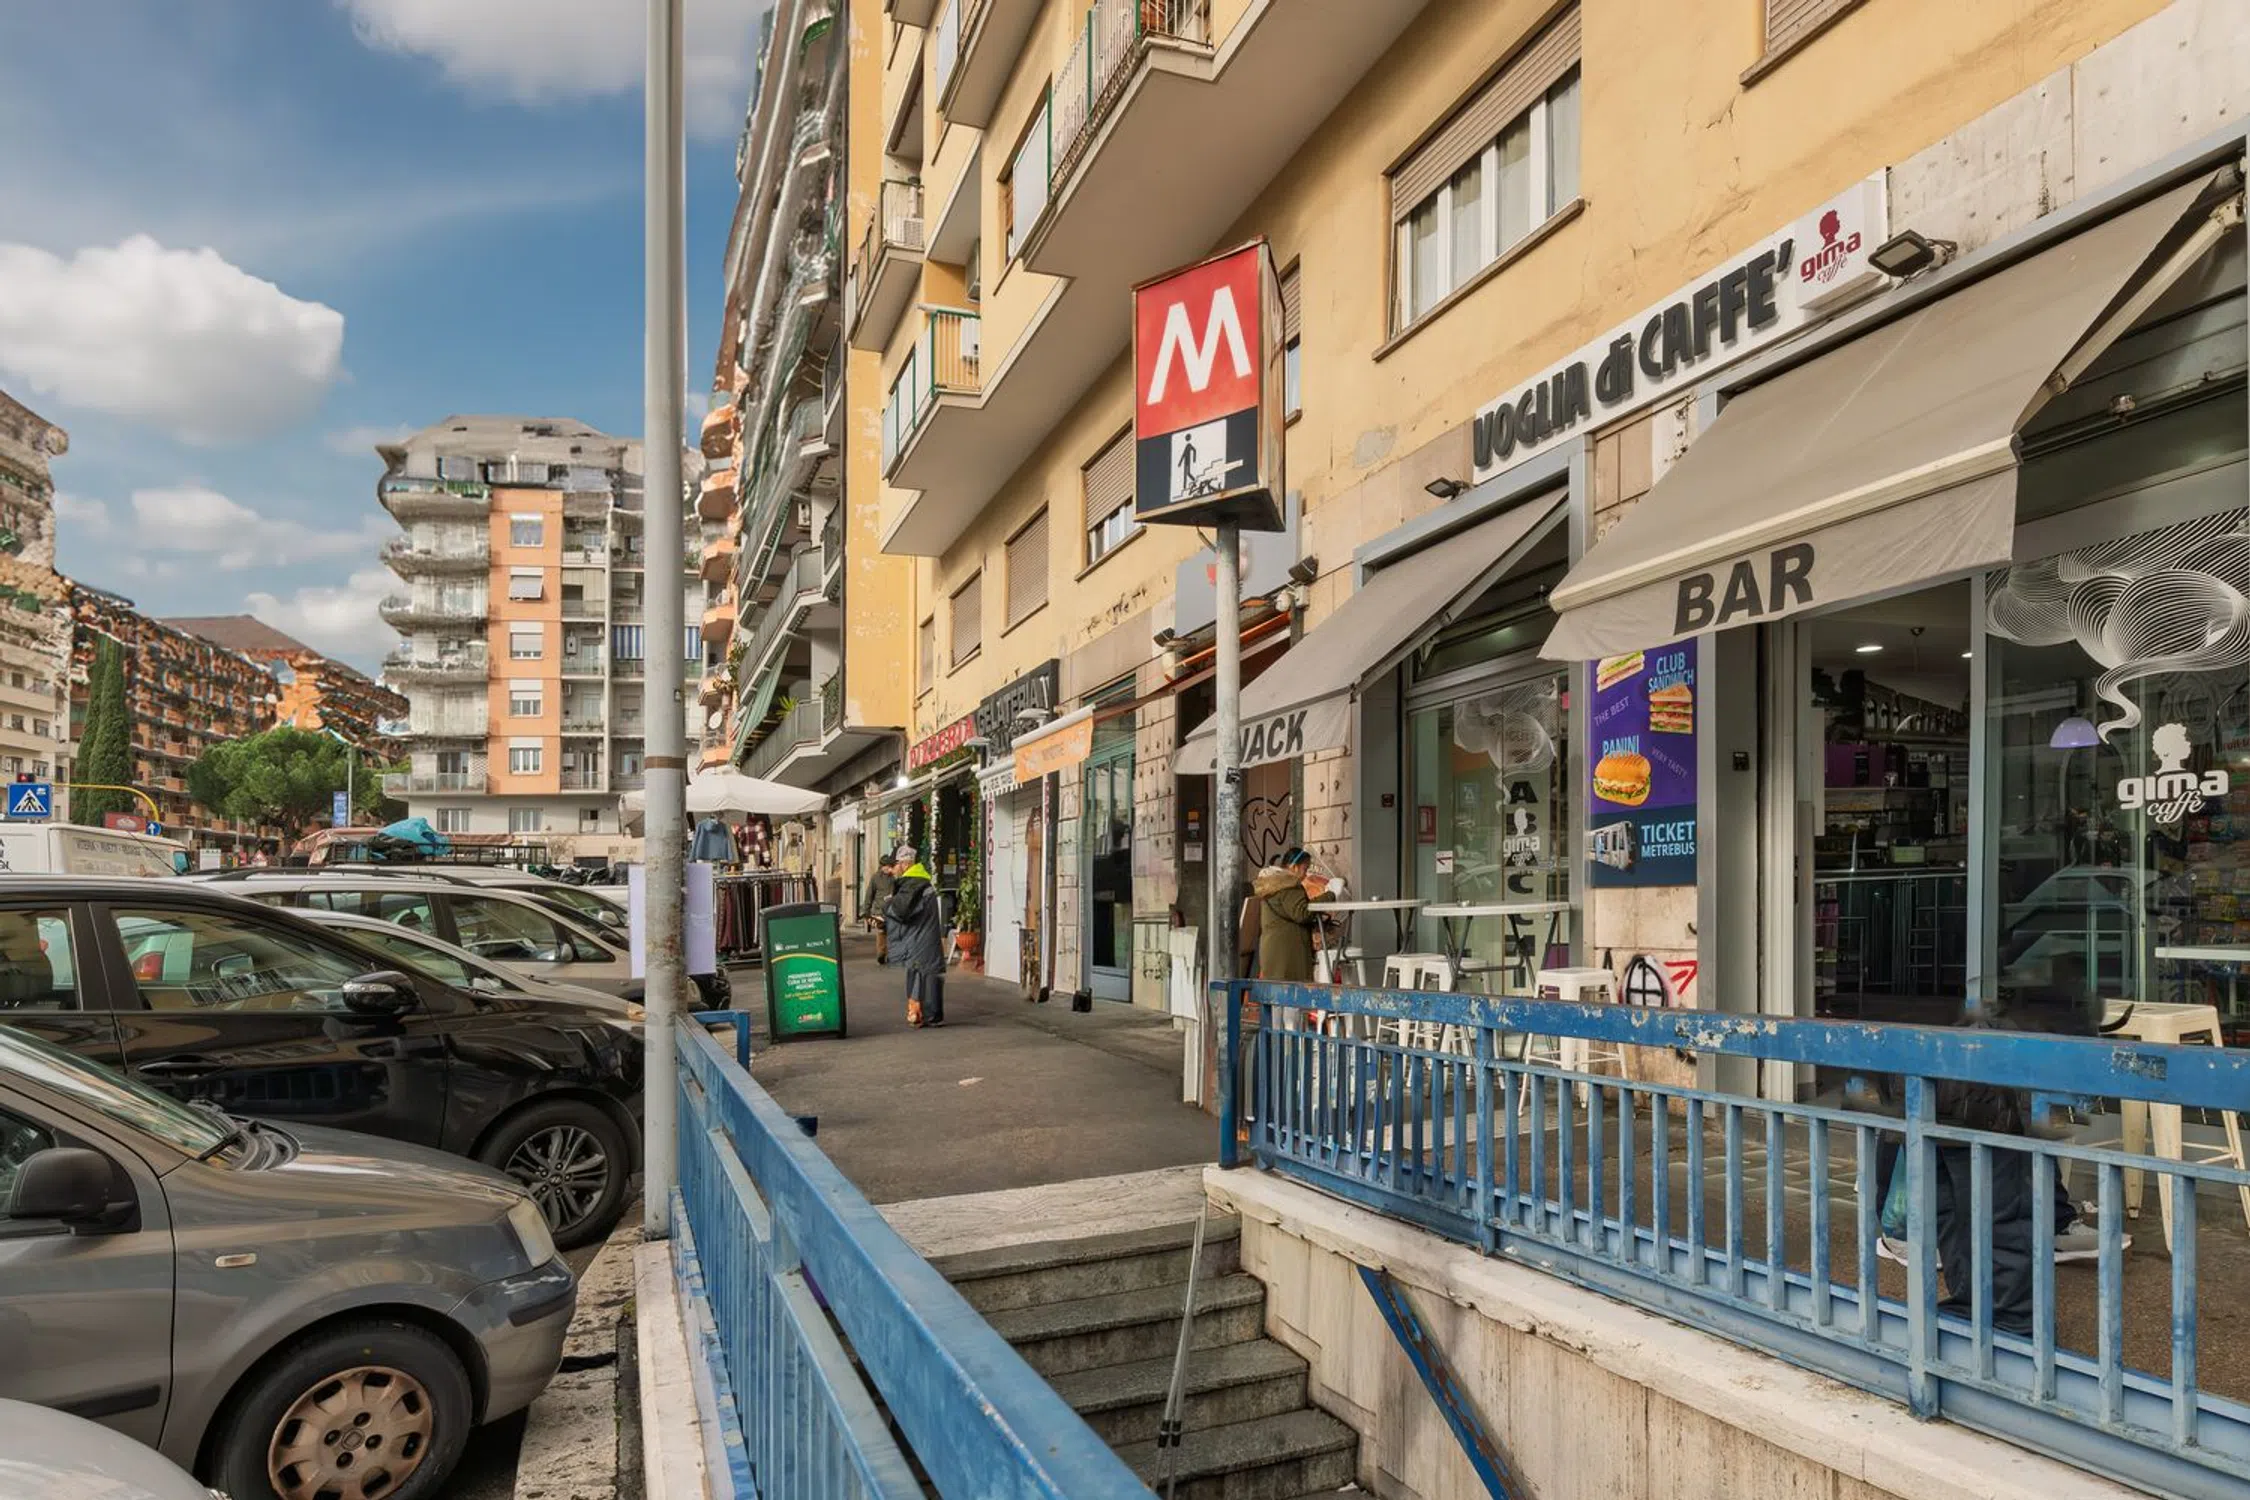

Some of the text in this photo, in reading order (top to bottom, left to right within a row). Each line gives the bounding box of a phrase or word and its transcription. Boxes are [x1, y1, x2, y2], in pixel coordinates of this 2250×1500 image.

[1800, 231, 1861, 283] gima
[1147, 285, 1253, 405] M
[1473, 238, 1794, 468] VOGLIA di CAFFE'
[1673, 542, 1815, 636] BAR
[1648, 668, 1695, 693] SANDWICH
[1655, 652, 1686, 675] CLUB
[976, 678, 1041, 736] GELATERIA
[1593, 696, 1630, 727] THE BEST
[908, 716, 977, 769] PIZZERIA
[1209, 709, 1308, 769] NACK
[1602, 735, 1640, 759] PANINI
[2117, 769, 2229, 810] gima
[1503, 835, 1541, 858] gima
[1641, 821, 1696, 843] TICKET
[1641, 841, 1696, 858] METREBUS
[1505, 750, 1539, 989] ABACCHI
